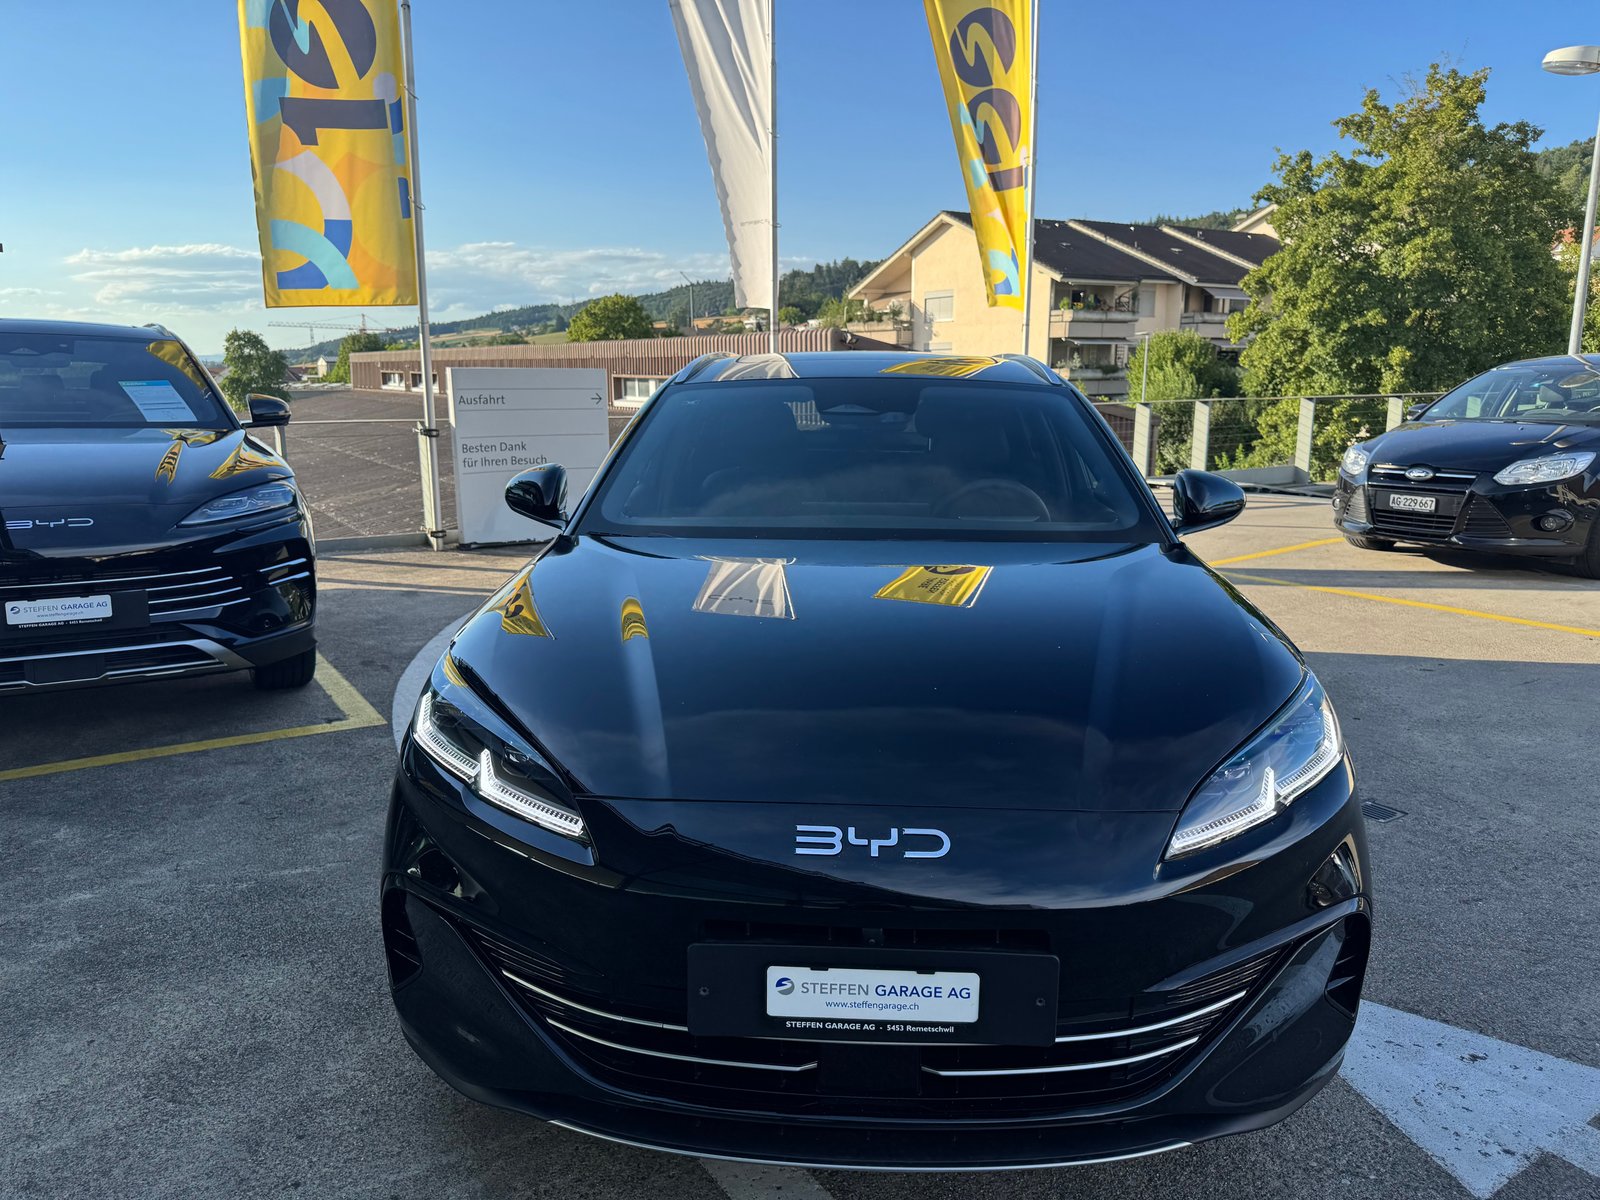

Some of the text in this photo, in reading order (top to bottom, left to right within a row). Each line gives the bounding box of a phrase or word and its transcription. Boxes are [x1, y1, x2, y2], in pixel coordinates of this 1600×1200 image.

[458, 394, 506, 406] Ausfahrt
[461, 441, 527, 454] Besten Dank
[462, 454, 548, 468] für Ihren Besuch
[5, 517, 94, 530] BYD
[24, 605, 58, 613] STEFFEN
[60, 602, 94, 610] GARAGE
[795, 824, 951, 858] BYD
[800, 981, 971, 999] STEFFEN GARAGE AG
[825, 1000, 920, 1011] www.steffengarage.ch
[785, 1020, 955, 1033] STEFFEN GARAGE AG 5453 Remetschwil
